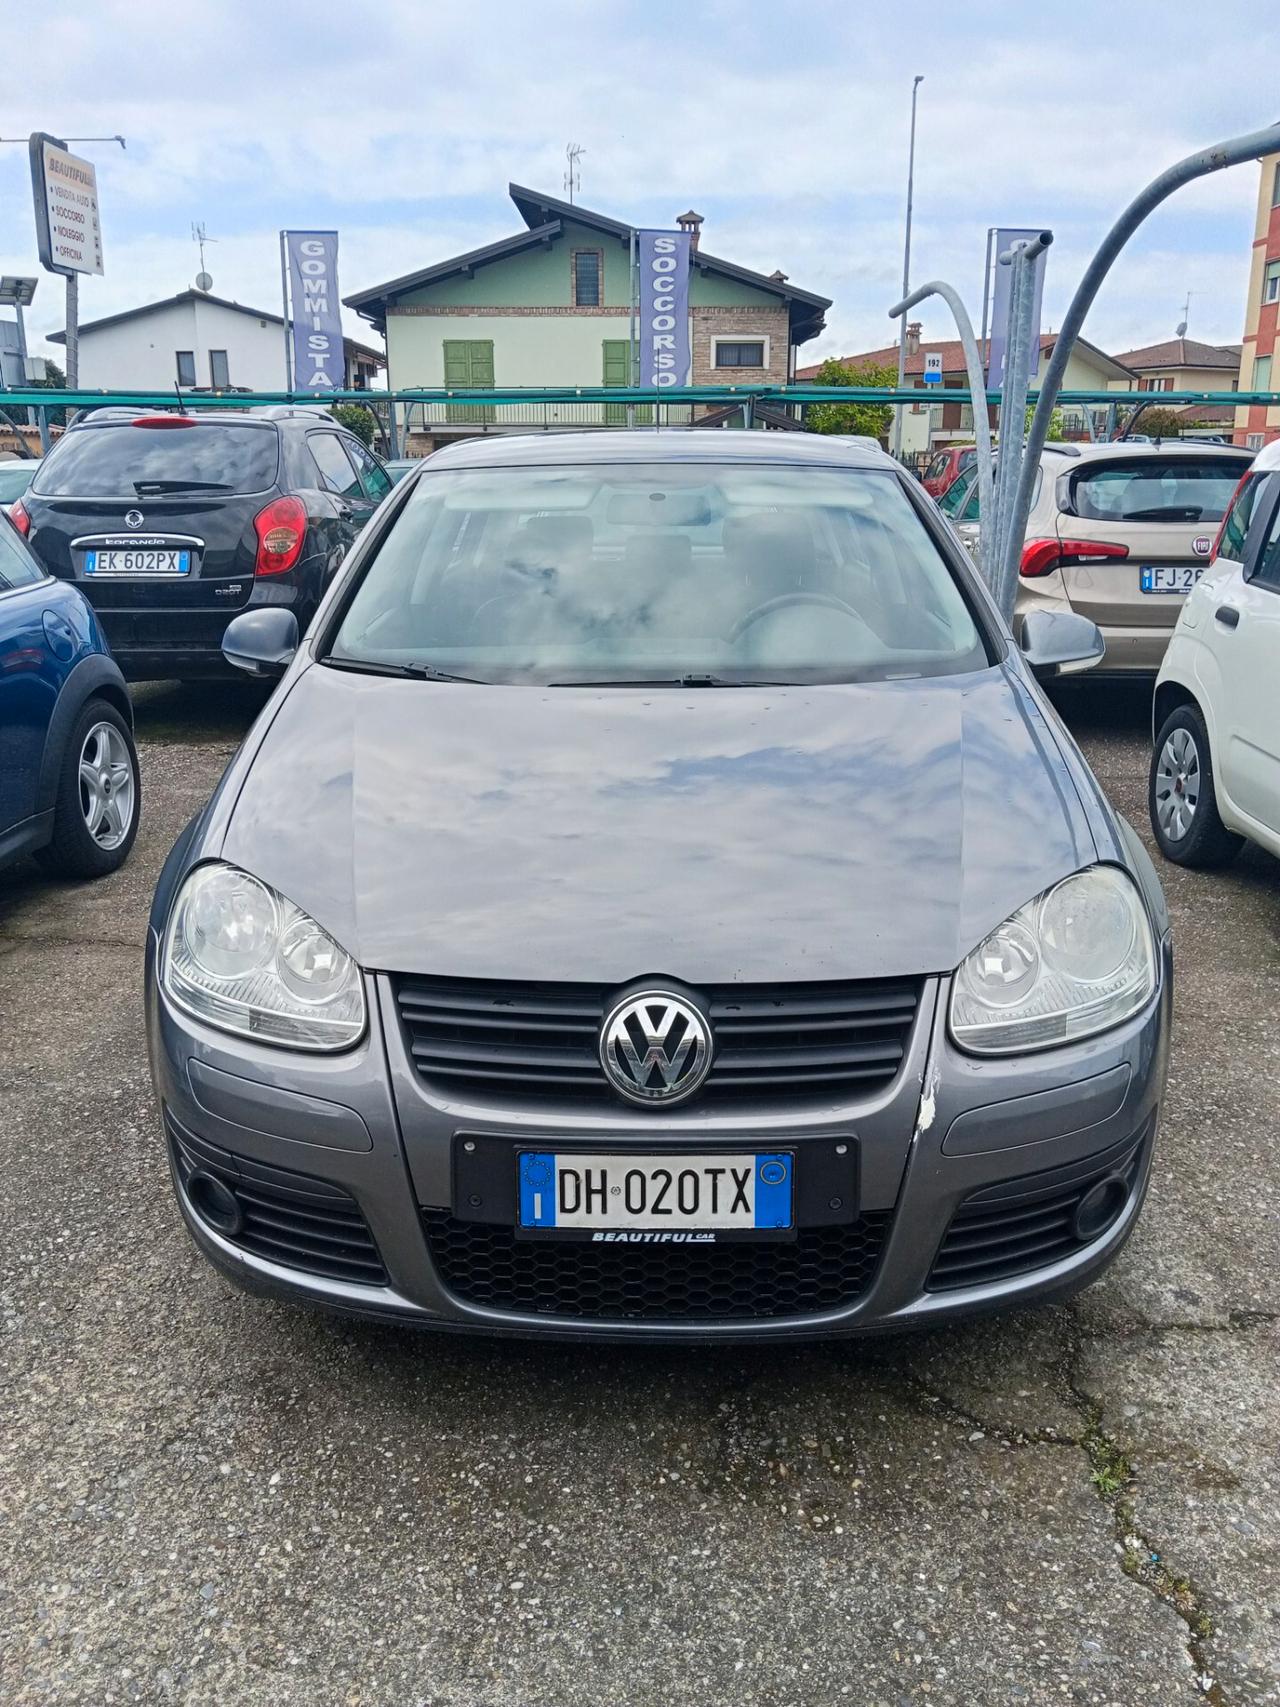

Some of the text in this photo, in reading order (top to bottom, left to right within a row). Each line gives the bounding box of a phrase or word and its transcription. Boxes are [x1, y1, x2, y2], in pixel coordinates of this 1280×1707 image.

[49, 158, 88, 184] BEAUTIFUL
[55, 205, 85, 225] SOCCORSO
[57, 224, 85, 243] NOLEGGIO
[59, 245, 83, 262] OFFICINA
[300, 240, 333, 387] GOMMISTA
[651, 237, 678, 388] SOCCORSO
[928, 359, 940, 367] 192
[592, 1232, 695, 1243] BEAUTIFUL
